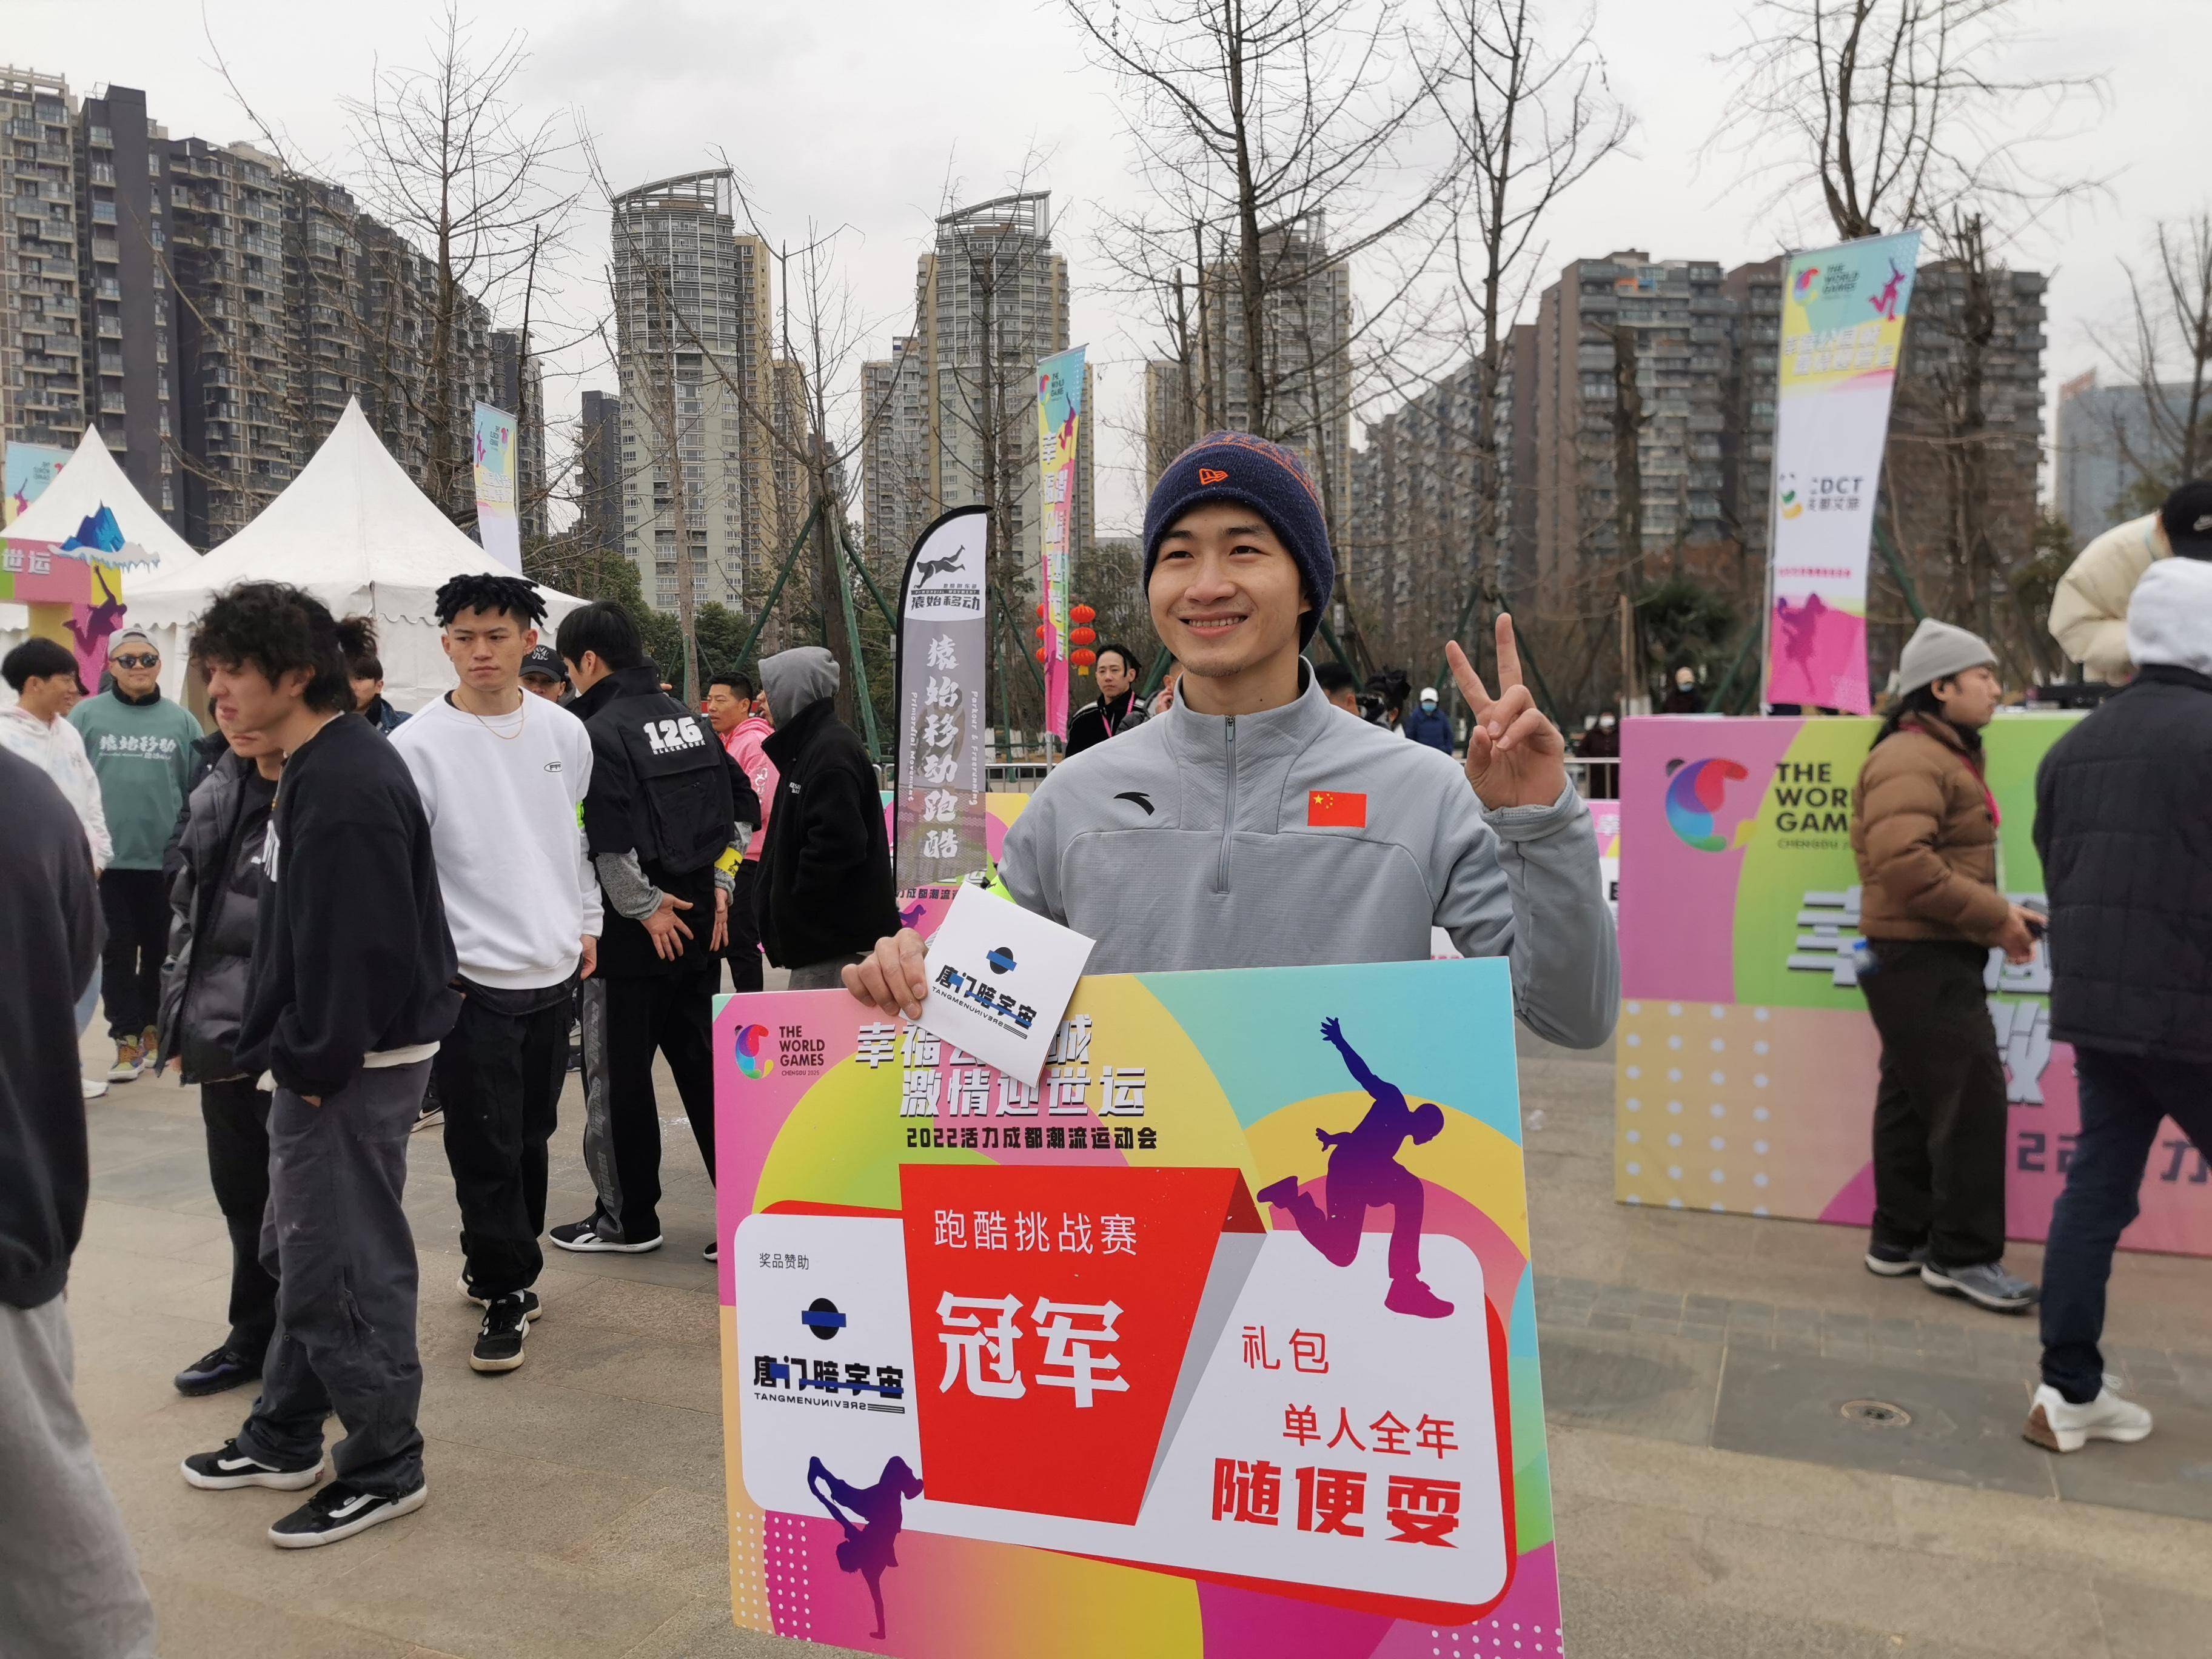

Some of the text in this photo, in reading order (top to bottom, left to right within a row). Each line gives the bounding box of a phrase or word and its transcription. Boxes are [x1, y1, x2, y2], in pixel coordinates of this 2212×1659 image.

[2, 548, 50, 575] 世运
[643, 717, 703, 750] 126
[923, 634, 959, 859] 猿始移动跑酷
[1776, 763, 1831, 783] THE
[1775, 788, 1848, 808] WOR
[1776, 812, 1848, 833] GAM
[779, 1025, 802, 1037] THE
[779, 1039, 825, 1052] WORLD
[856, 1014, 1092, 1068] 幸福城
[780, 1053, 824, 1067] GAMES
[900, 1065, 1146, 1118] 激情迎世运
[907, 1127, 1157, 1150] 2022活力成都潮流运动会
[934, 1209, 1138, 1256] 跑酷挑战赛
[759, 1252, 809, 1270] 奖品赞助
[935, 1290, 1131, 1409] 冠军
[1242, 1326, 1329, 1374] 礼包
[1282, 1403, 1458, 1459] 单人全年
[1212, 1457, 1461, 1549] 随便耍
